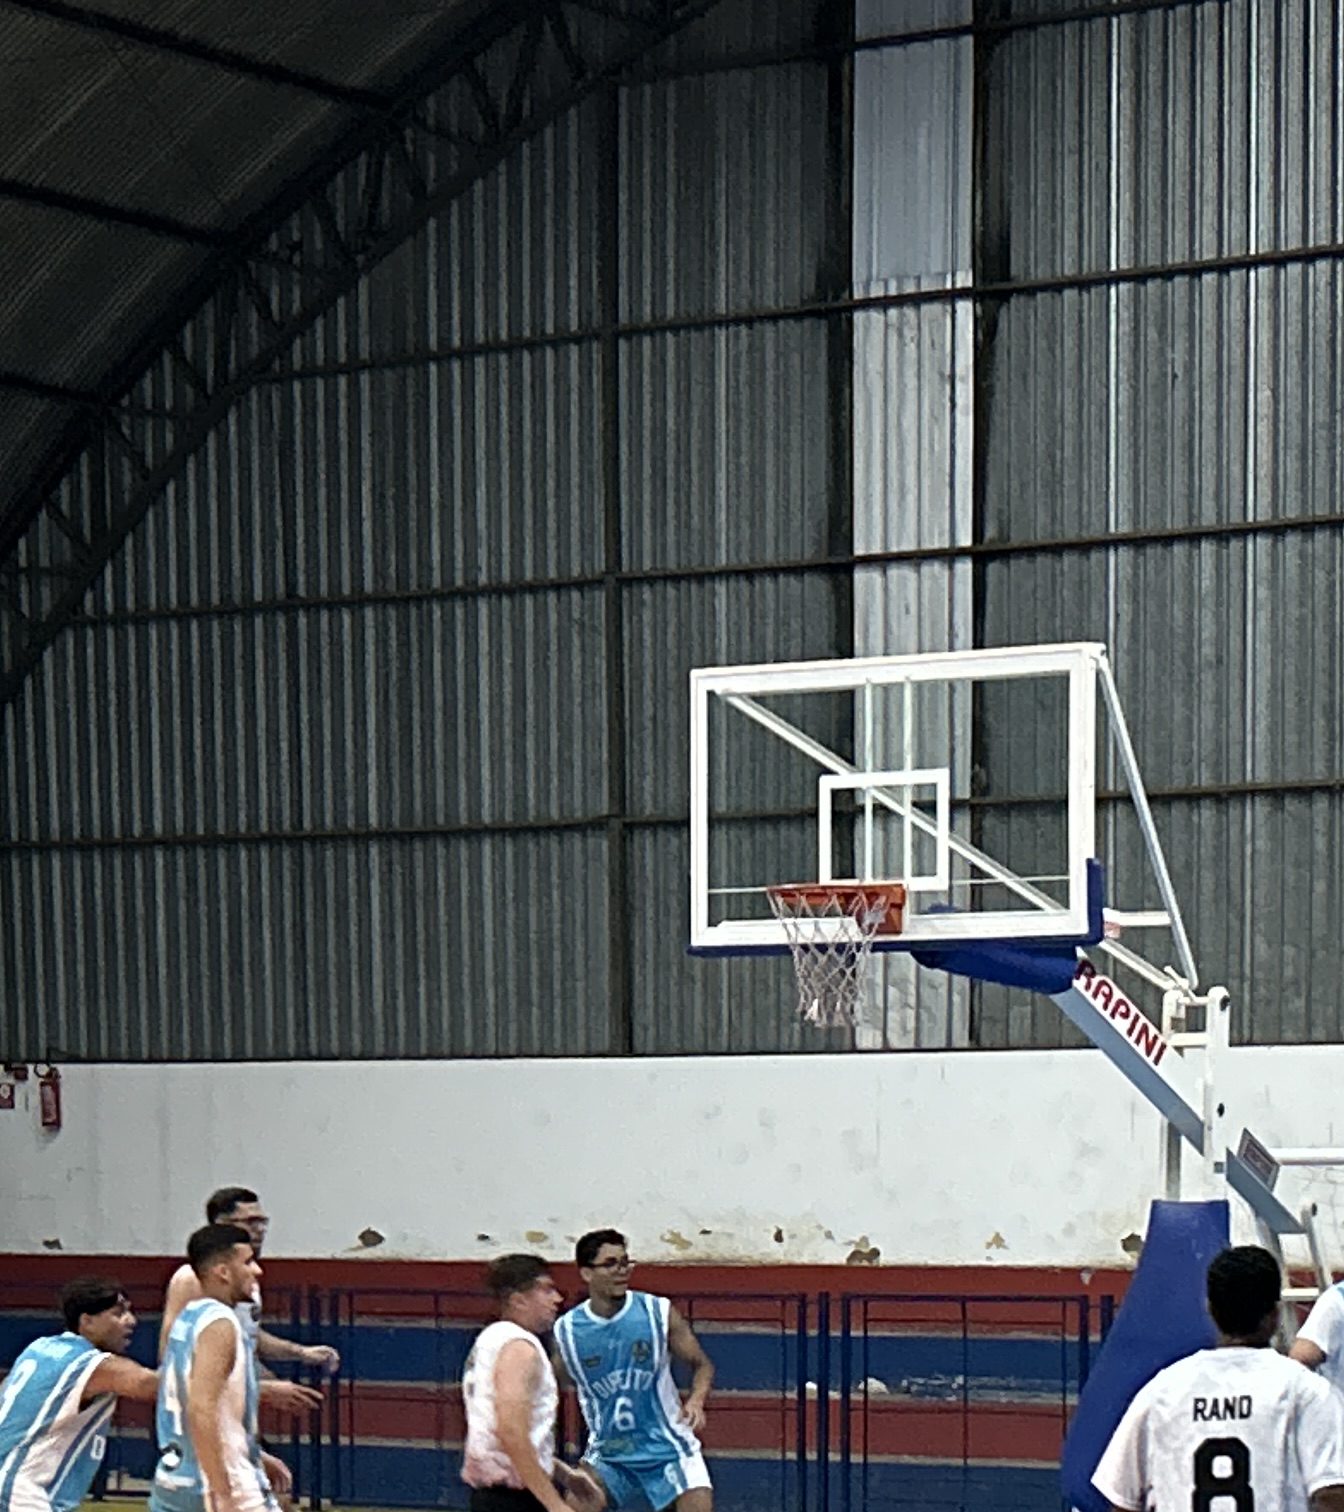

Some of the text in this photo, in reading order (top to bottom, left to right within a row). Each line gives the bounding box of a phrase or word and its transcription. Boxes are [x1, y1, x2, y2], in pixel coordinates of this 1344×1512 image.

[1074, 959, 1167, 1066] RAPINI
[614, 1396, 636, 1432] 6
[1193, 1395, 1253, 1422] RAND
